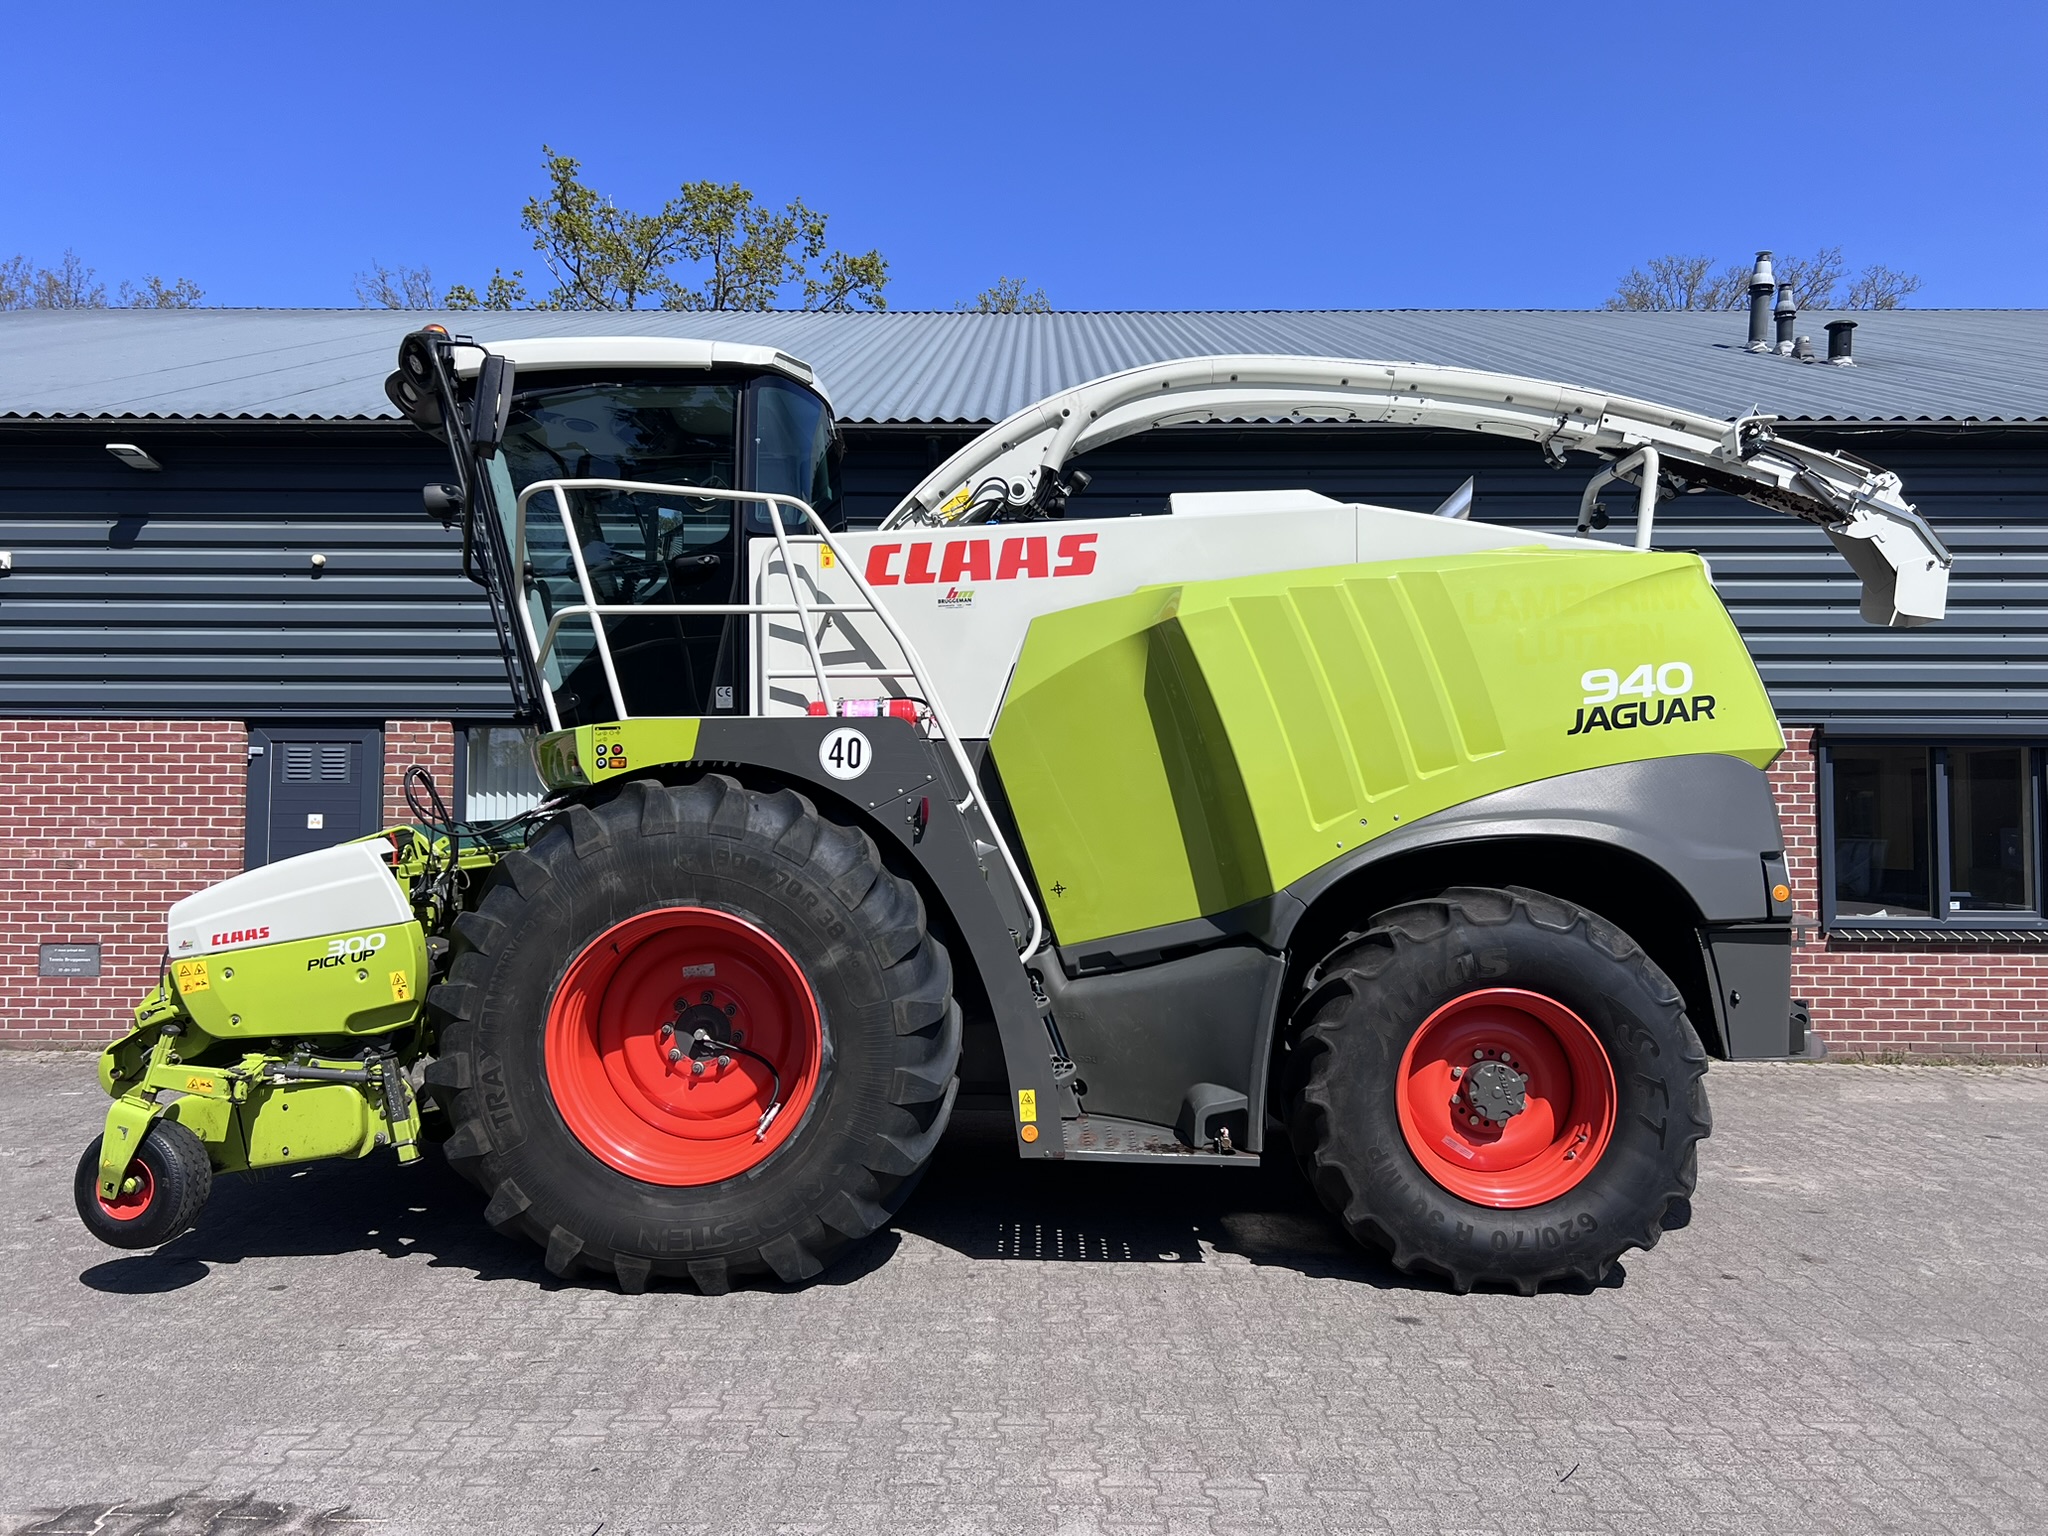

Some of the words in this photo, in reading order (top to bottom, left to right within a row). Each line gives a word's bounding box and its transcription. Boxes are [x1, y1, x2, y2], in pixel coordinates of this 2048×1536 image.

[864, 532, 1099, 586] CLAAS
[1580, 660, 1694, 705] 940
[1566, 694, 1717, 737] JAGUAR
[828, 736, 862, 771] 40
[211, 926, 271, 947] CLAAS
[817, 908, 847, 941] 38
[307, 953, 348, 971] PICK
[351, 949, 376, 963] UP
[326, 932, 386, 957] 300
[478, 989, 514, 1130] TRAXION
[1456, 1221, 1475, 1244] R
[1490, 1212, 1599, 1252] 620/70
